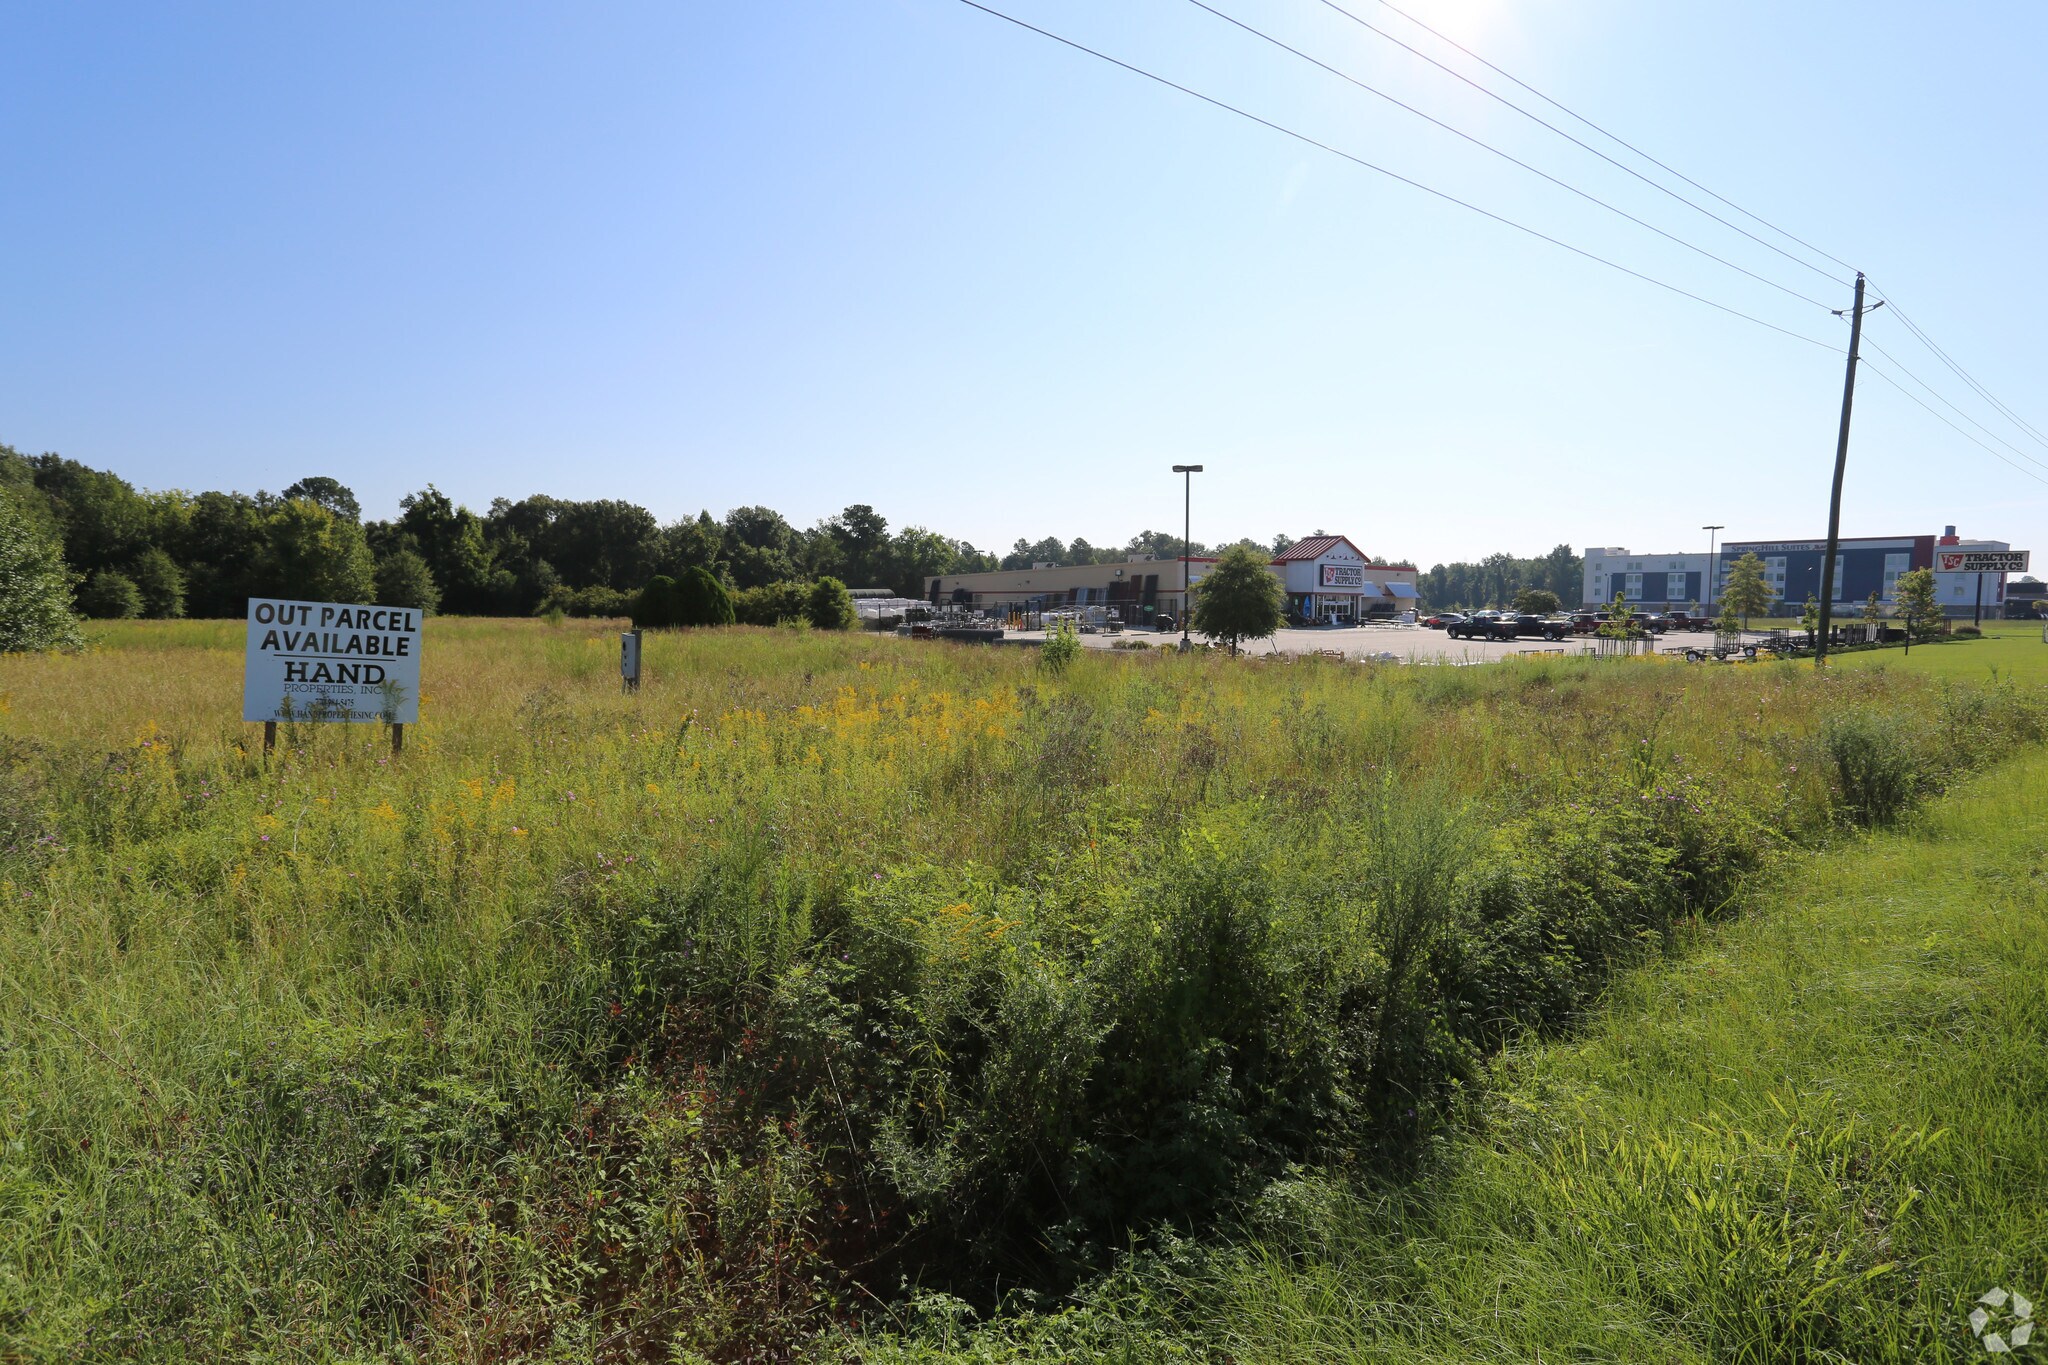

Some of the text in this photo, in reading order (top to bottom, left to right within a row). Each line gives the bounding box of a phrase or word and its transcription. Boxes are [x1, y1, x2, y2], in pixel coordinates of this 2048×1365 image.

[1943, 555, 1960, 567] TSC
[1965, 553, 2023, 562] TRACTOR
[1335, 567, 1361, 576] TRACTOR
[1964, 562, 2008, 571] SUPPLY
[1335, 576, 1354, 585] SUPPLY
[255, 603, 416, 632] OUT PARCEL
[260, 630, 410, 657] AVAILABLE
[284, 661, 386, 685] HAND
